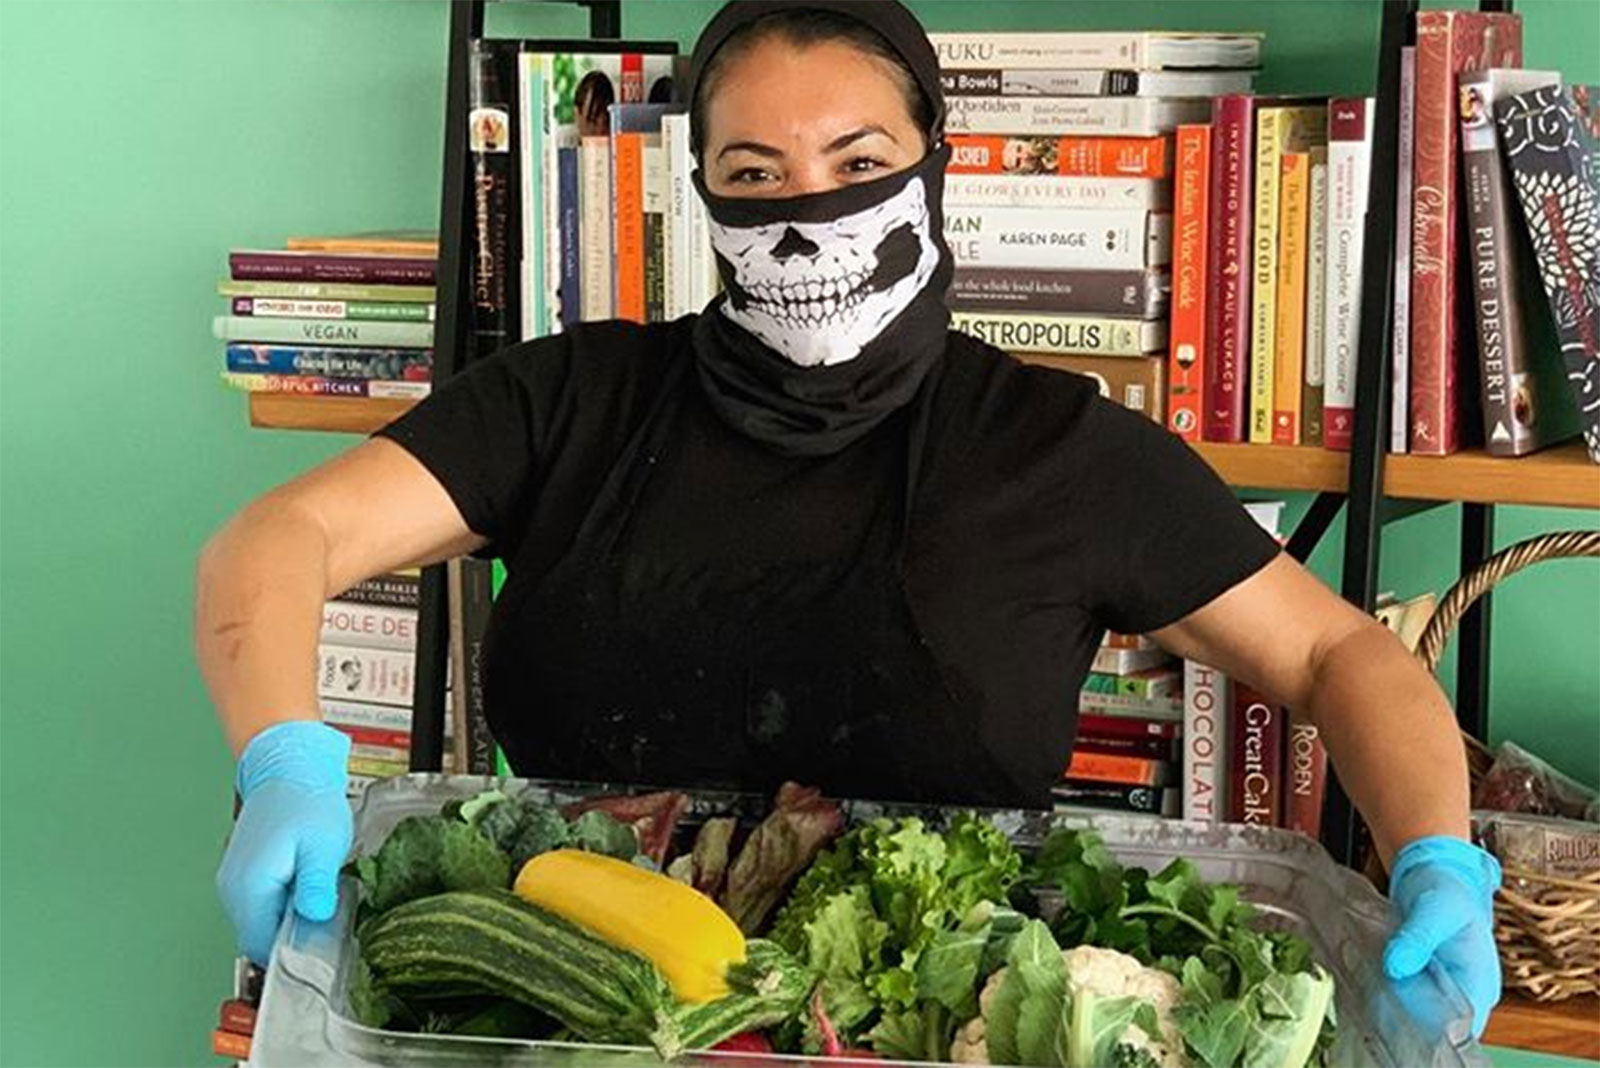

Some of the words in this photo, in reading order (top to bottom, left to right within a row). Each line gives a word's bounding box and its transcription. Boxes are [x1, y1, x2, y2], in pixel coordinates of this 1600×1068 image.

[999, 232, 1050, 246] KAREN
[1050, 233, 1088, 247] PAGE
[1181, 221, 1199, 264] Wine
[1226, 218, 1238, 256] WINE
[1335, 229, 1353, 299] Complete
[1474, 226, 1497, 291] PURE
[473, 253, 494, 313] Chef
[983, 280, 1010, 292] whole
[1013, 280, 1033, 293] food
[1036, 280, 1072, 294] kitchen
[1224, 280, 1235, 321] PAUL
[302, 323, 359, 340] VEGAN
[947, 318, 1101, 349] ASTROPOLIS
[1336, 302, 1350, 338] Wine
[1336, 342, 1349, 395] Course
[1480, 298, 1506, 407] DESSERT
[312, 381, 361, 394] KITCHEN
